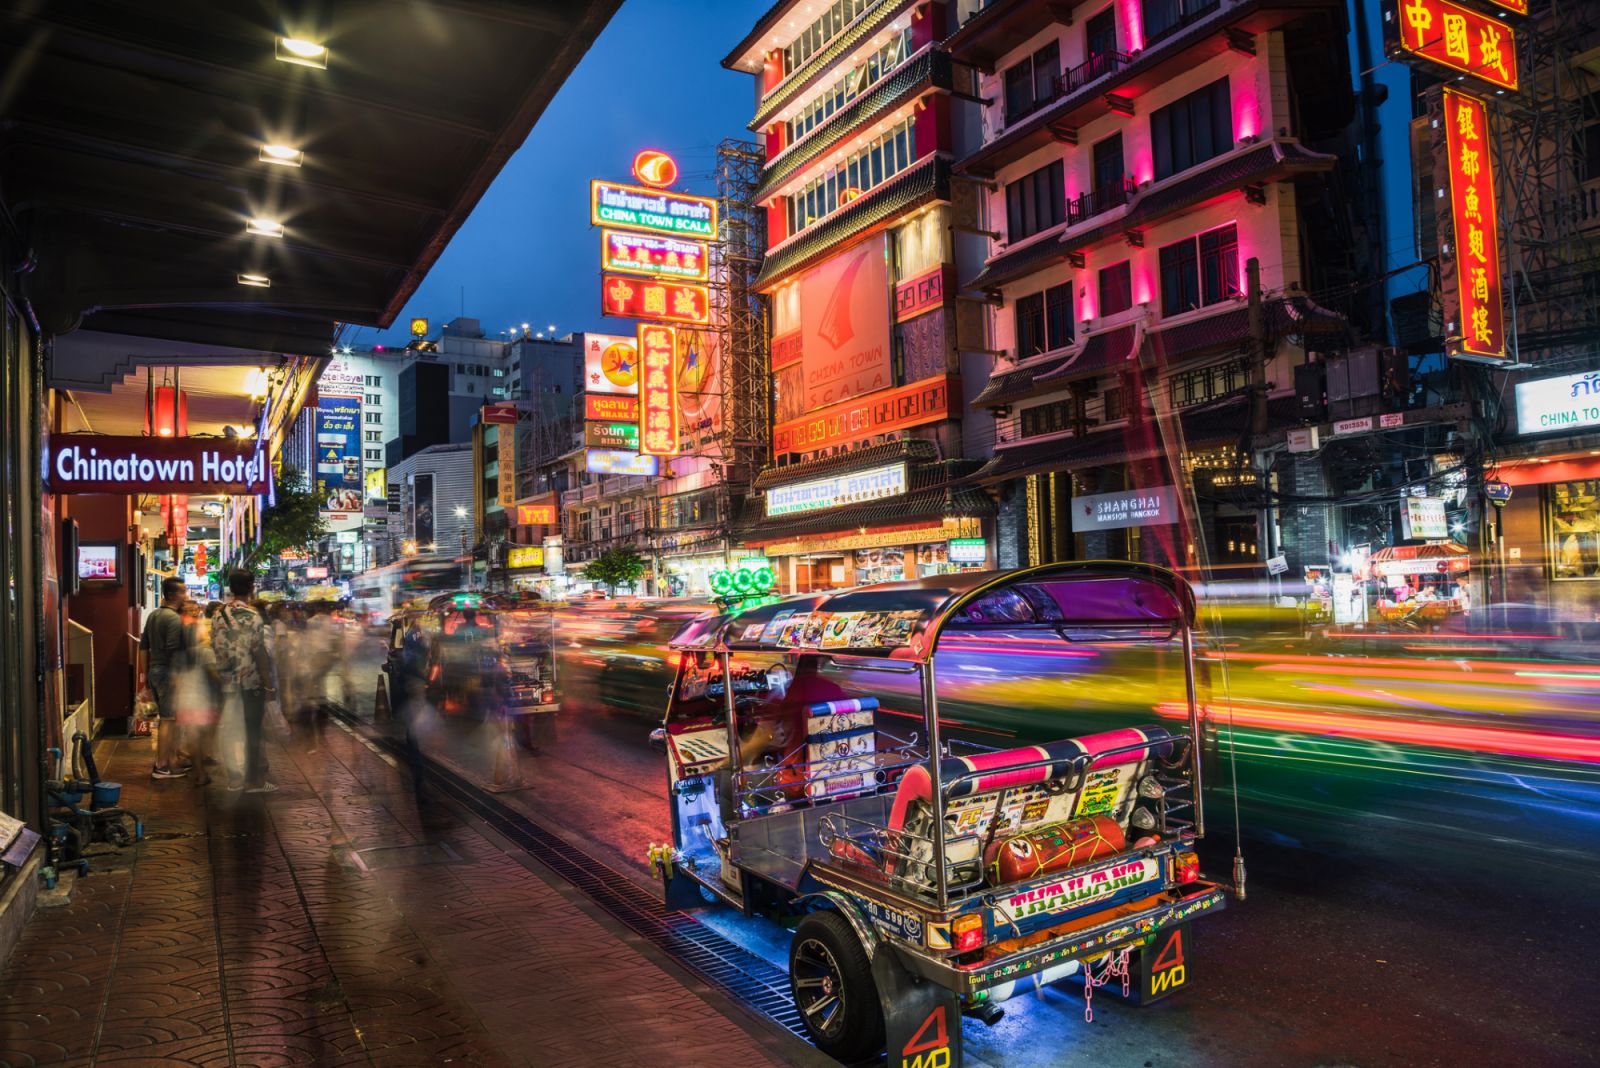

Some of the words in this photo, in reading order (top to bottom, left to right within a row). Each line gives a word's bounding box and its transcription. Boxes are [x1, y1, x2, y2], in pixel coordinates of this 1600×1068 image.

[1405, 0, 1508, 81] 中國城
[601, 207, 637, 223] CHINA
[639, 212, 673, 228] TOWN
[675, 218, 712, 233] SCALA
[1456, 104, 1493, 346] 銀都魚翅酒樓
[610, 280, 700, 320] 中國城
[809, 361, 844, 383] CHINA
[849, 345, 882, 368] TOWN
[592, 399, 629, 412] หูฉลาม
[810, 372, 882, 408] SCALA
[600, 410, 630, 418] SHARK
[1540, 410, 1579, 426] CHINA
[601, 437, 623, 445] BIRD
[56, 446, 194, 482] Chinatown
[202, 450, 265, 482] Hotel
[1097, 496, 1160, 513] SHANGHAI
[1097, 512, 1128, 522] MANSION
[1130, 509, 1160, 519] BANGKOK
[1010, 860, 1145, 918] THAILAND
[1152, 929, 1184, 973] 4
[1152, 965, 1185, 995] WD
[902, 1006, 949, 1056] 4
